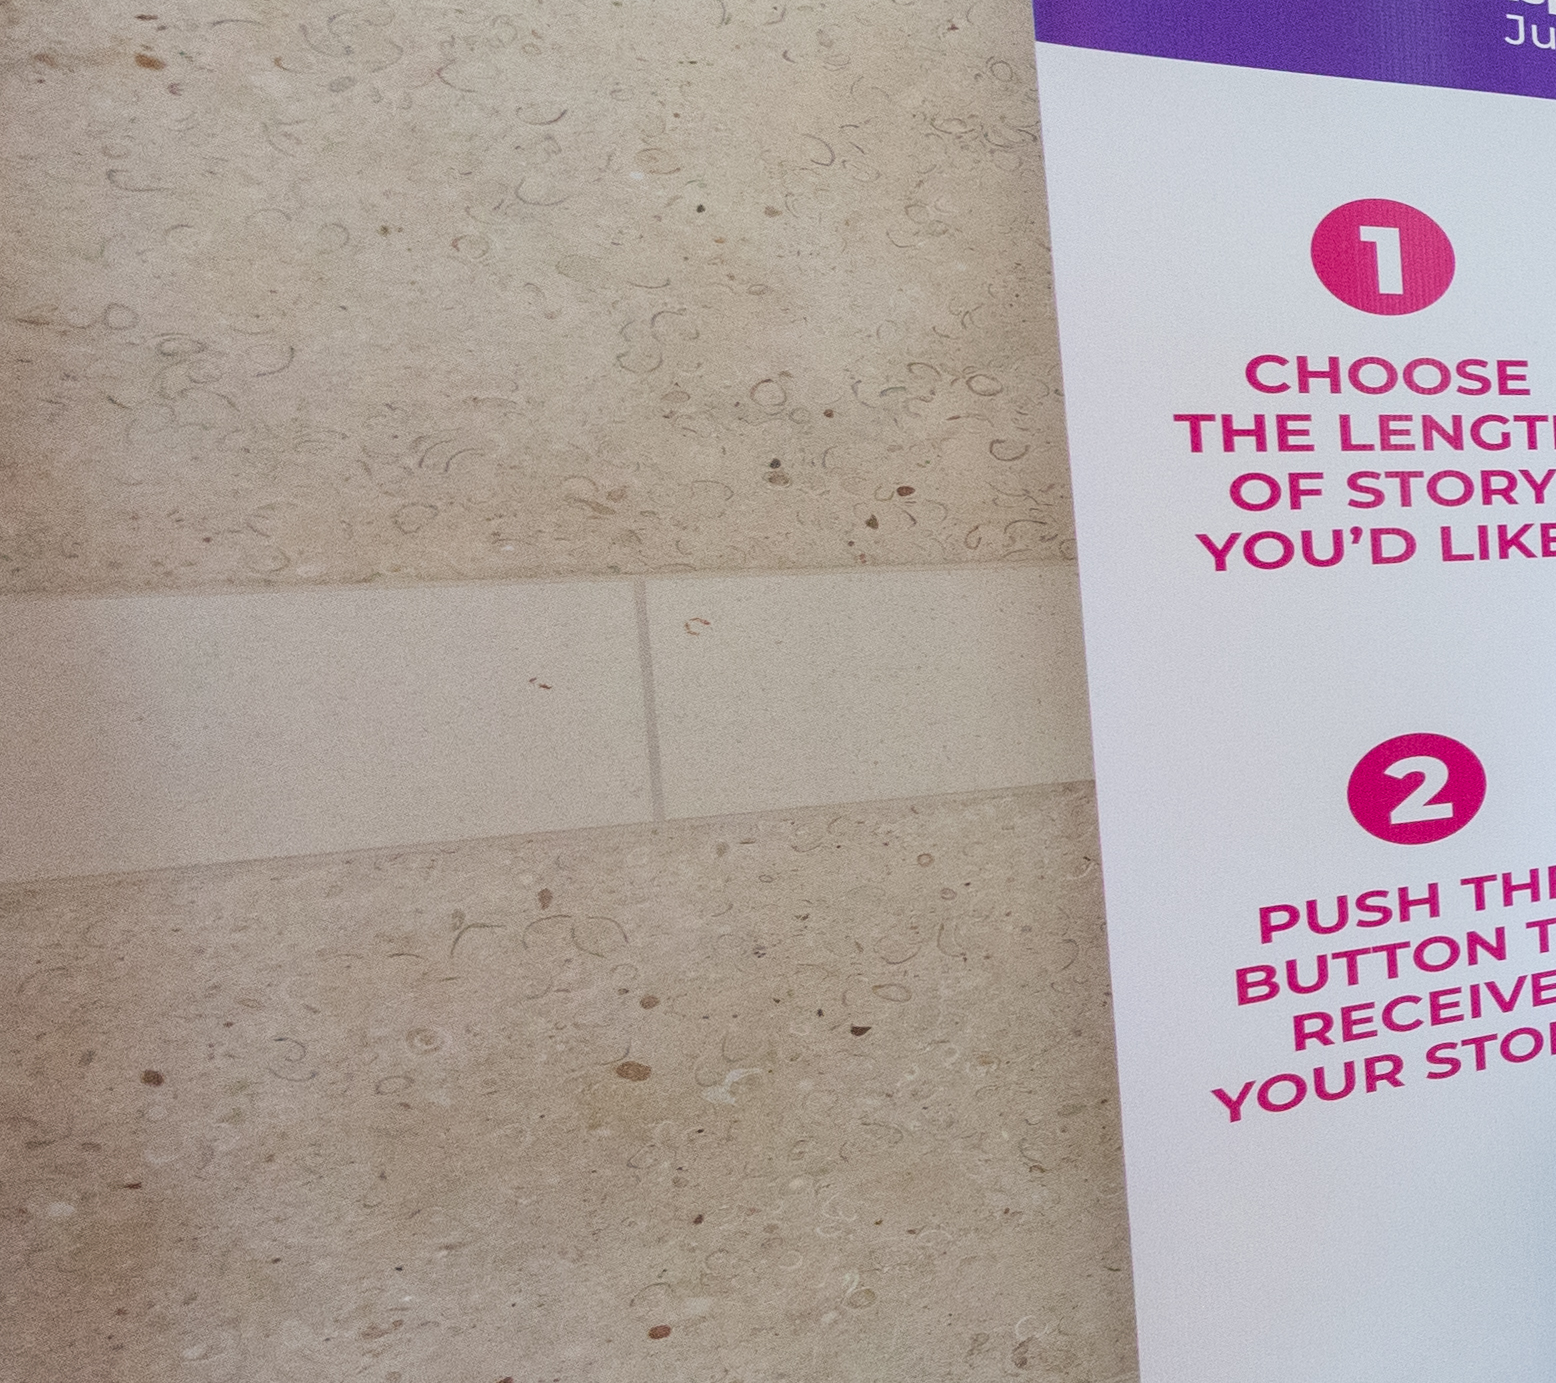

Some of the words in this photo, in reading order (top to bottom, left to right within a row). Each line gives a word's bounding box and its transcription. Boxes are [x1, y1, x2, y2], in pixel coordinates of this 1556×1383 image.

[1360, 226, 1403, 294] 1
[1245, 355, 1530, 395] CHOOSE
[1173, 414, 1314, 453] THE
[1230, 472, 1323, 511] OF
[1347, 469, 1556, 509] STORY
[1196, 526, 1416, 571] YOU'D
[1385, 756, 1453, 824] 2
[1259, 883, 1440, 944] PUSH
[1236, 927, 1506, 1005] BUTTON
[1211, 1054, 1404, 1122] YOUR
